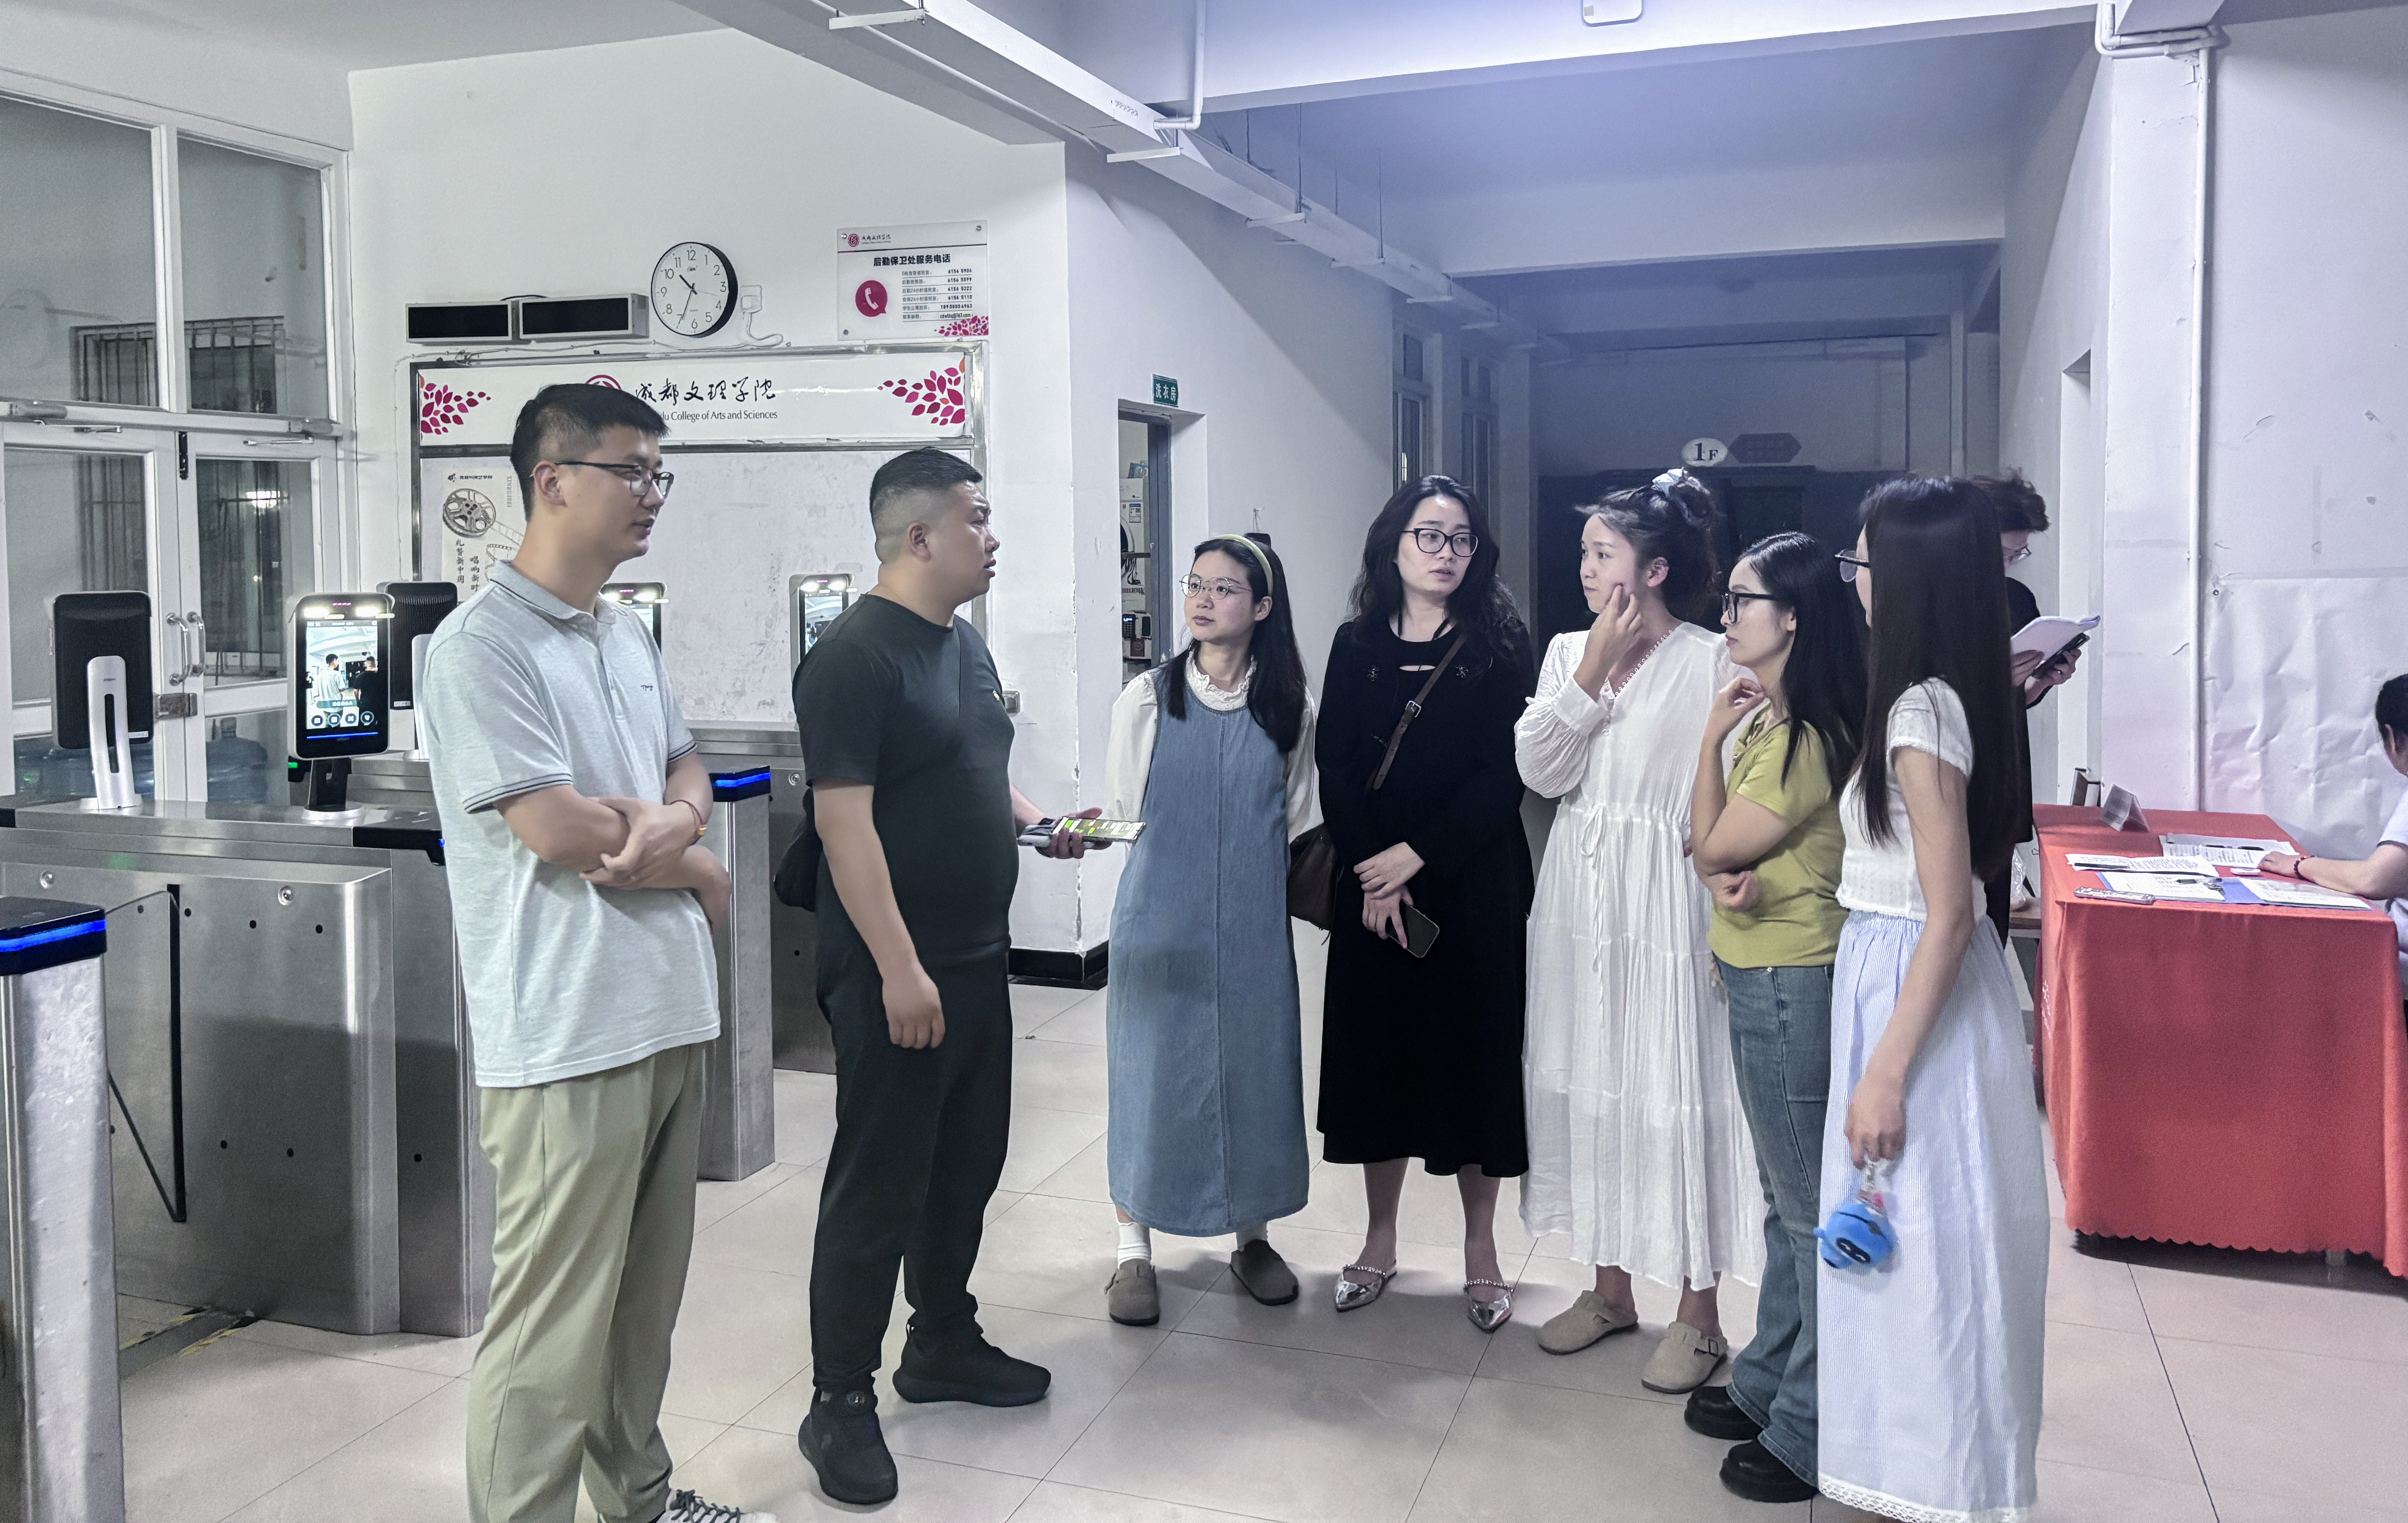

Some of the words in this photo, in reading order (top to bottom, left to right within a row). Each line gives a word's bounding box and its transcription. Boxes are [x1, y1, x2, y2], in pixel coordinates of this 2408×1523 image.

[687, 250, 696, 261] 12
[704, 255, 708, 265] 1
[873, 254, 951, 266] 后勤保卫处服务电话
[675, 257, 681, 268] 11
[664, 269, 674, 279] 10
[714, 265, 720, 275] 2
[661, 287, 667, 297] 9
[720, 281, 726, 292] 3
[666, 304, 672, 314] 8
[715, 300, 721, 310] 4
[677, 314, 683, 325] 7
[706, 312, 712, 322] 5
[691, 318, 698, 329] 6
[636, 377, 776, 406] 成都文理学院
[1156, 383, 1177, 401] 洗衣房
[671, 411, 700, 422] College
[701, 410, 710, 420] of
[711, 411, 726, 420] Arts
[727, 409, 742, 419] and
[743, 410, 778, 419] Sciences
[456, 539, 465, 584] 礼赞新中国
